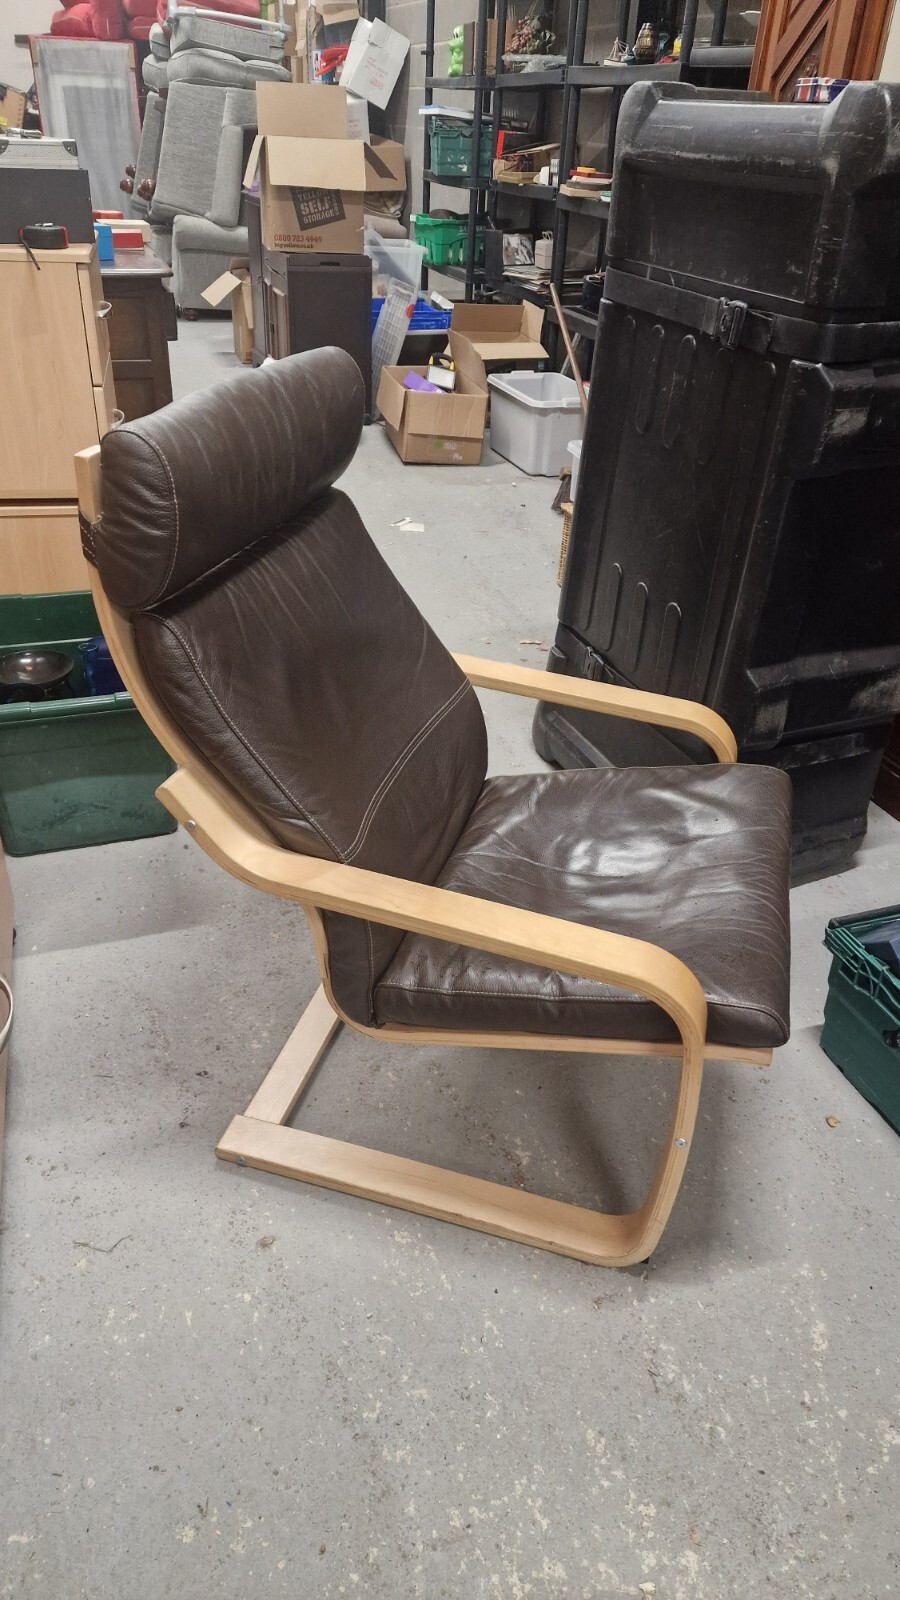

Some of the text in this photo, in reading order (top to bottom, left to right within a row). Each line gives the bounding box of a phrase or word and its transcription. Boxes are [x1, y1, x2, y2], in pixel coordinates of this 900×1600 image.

[297, 189, 330, 202] YELLOW
[300, 196, 331, 215] SELF
[303, 208, 334, 224] STORAGE
[274, 234, 291, 242] 0800
[306, 235, 322, 244] 4949
